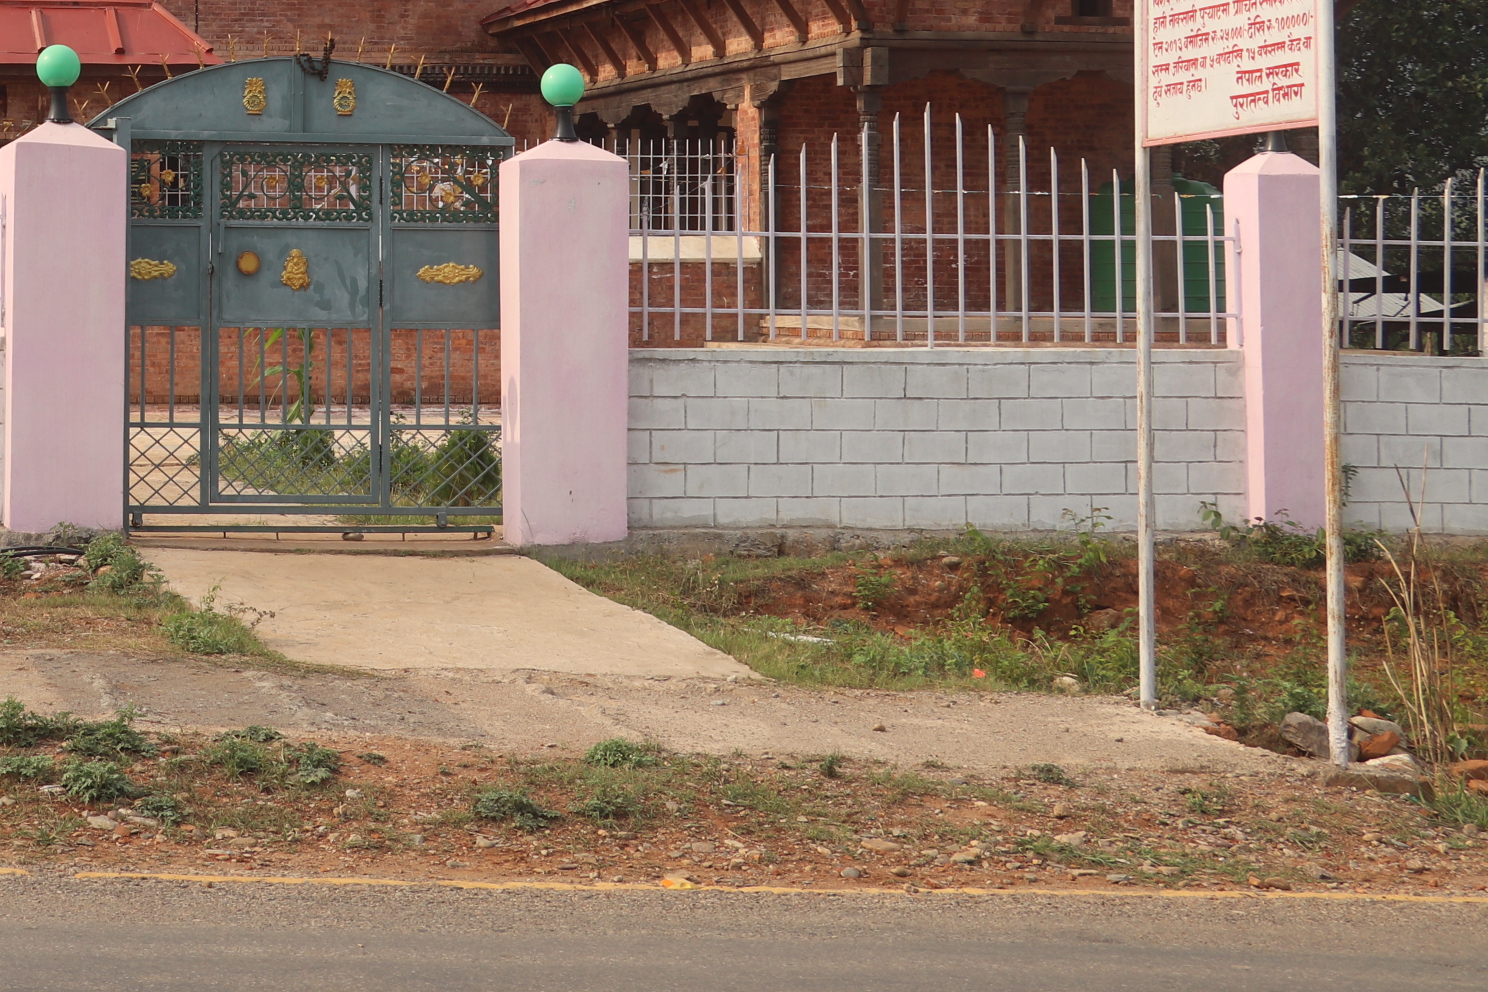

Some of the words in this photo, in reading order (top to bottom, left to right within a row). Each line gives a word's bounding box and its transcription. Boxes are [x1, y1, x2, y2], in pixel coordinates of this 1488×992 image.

[1165, 37, 1182, 54] २०१३
[1247, 14, 1265, 39] देखि
[1152, 63, 1170, 79] सम्म
[1199, 56, 1207, 70] वा
[1209, 55, 1214, 68] ५
[1245, 48, 1256, 62] १५
[1287, 32, 1302, 52] कैद
[1302, 36, 1312, 51] वा
[1236, 64, 1263, 86] नेपाल
[1265, 61, 1302, 83] सरकार
[1152, 78, 1163, 107] दुवै
[1229, 90, 1269, 120] पुरातत्व
[1271, 82, 1305, 105] विभाग
